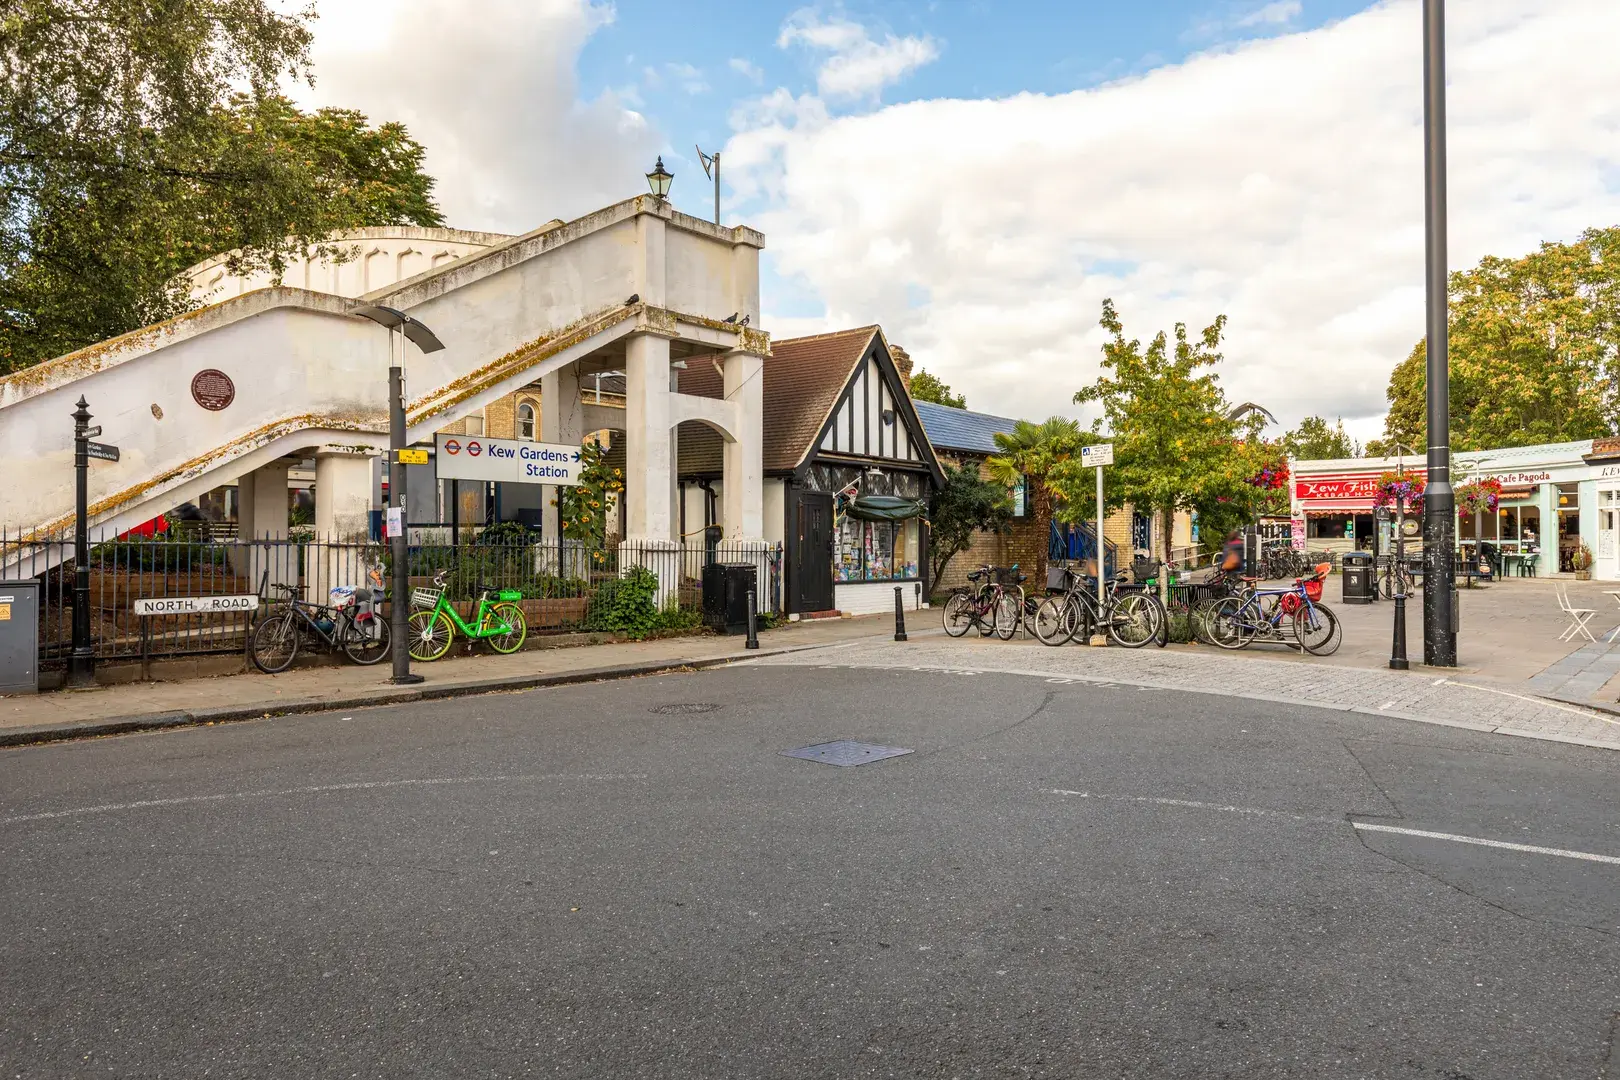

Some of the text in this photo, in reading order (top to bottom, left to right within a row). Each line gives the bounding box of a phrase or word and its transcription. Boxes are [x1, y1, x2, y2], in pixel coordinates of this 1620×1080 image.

[488, 444, 569, 463] Kew Gardens
[526, 463, 569, 478] Station
[1496, 471, 1551, 484] Cafe Pagoda
[1302, 481, 1378, 496] Kew Fish
[144, 598, 250, 612] NORTH ROAD
